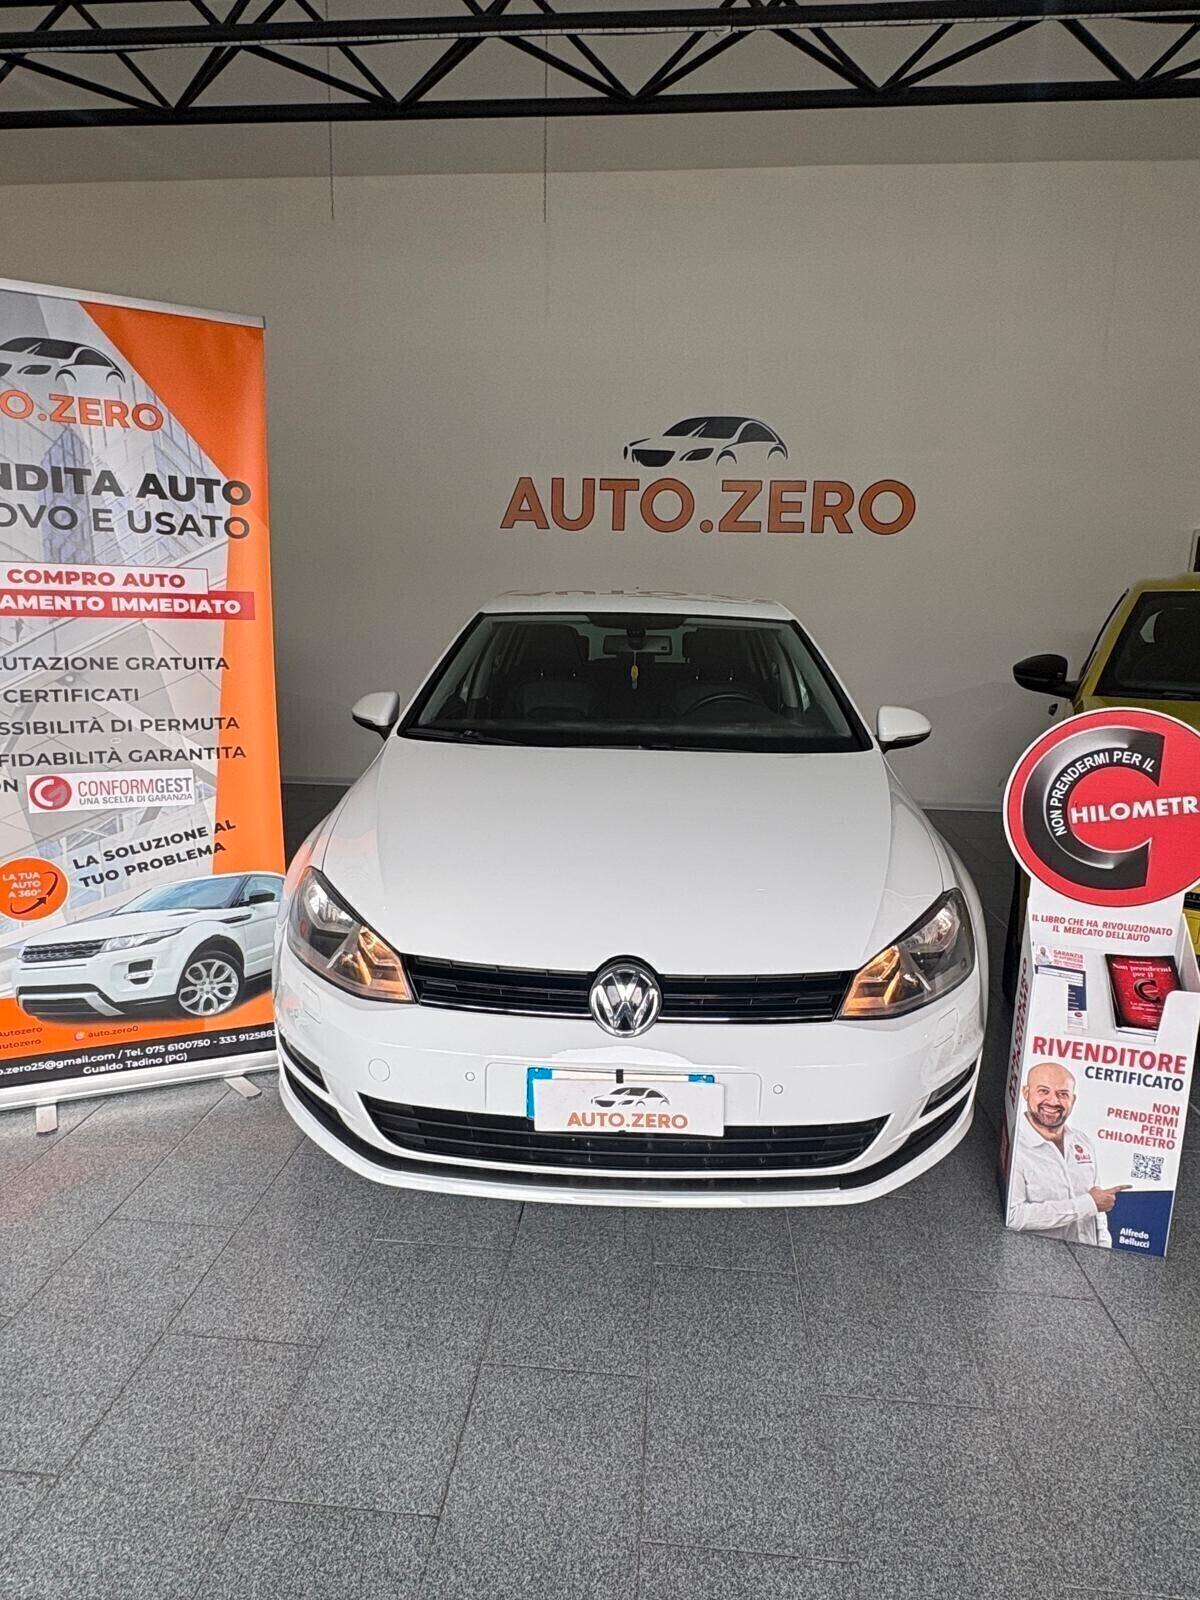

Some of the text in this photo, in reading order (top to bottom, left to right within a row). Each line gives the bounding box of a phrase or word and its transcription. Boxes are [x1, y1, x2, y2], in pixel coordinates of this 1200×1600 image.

[136, 473, 252, 506] AUTO
[499, 476, 917, 536] AUTO.ZERO
[93, 508, 115, 532] E
[127, 510, 250, 540] USATO
[6, 569, 186, 589] COMPRO AUTO
[0, 593, 241, 615] AMENTO IMMEDIATO
[0, 656, 230, 671] UTAZIONE GRATUITA
[3, 688, 139, 704] CERTIFICATI
[111, 719, 133, 733] DI
[140, 717, 240, 733] PERMUTA
[128, 746, 247, 764] GARANTITA
[78, 777, 192, 797] CONFORMGEST
[1050, 750, 1155, 837] NON PRENDERMI PER IL
[79, 793, 193, 806] UNA SCELTA DI GARANZIA
[72, 819, 237, 870] LA SOLUZIONE AL
[78, 842, 228, 889] TUO PROBLEMA
[2, 872, 40, 881] LA TUA
[11, 880, 41, 889] AUTO
[1032, 914, 1173, 937] IL LIBRO CHE HA RIVOLUZIONATO
[1052, 925, 1150, 943] IL MERCATO DELL'AUTO
[125, 1046, 144, 1058] Tel.
[145, 1043, 165, 1055] 075
[167, 1038, 211, 1052] 6100750
[219, 1033, 238, 1045] 333
[1032, 1036, 1188, 1075] RIVENDITORE
[83, 1051, 188, 1075] Gualdo Tadino (PG)
[1084, 1065, 1184, 1092] CERTIFICATO
[1107, 1107, 1179, 1128] PRENDERMI
[1152, 1102, 1180, 1116] NON
[567, 1111, 688, 1129] AUTO.ZERO
[1097, 1129, 1176, 1150] CHILOMETRO
[1141, 1124, 1178, 1140] PER IL
[1119, 1236, 1150, 1249] Bellucci
[1120, 1227, 1149, 1240] Alfredo
